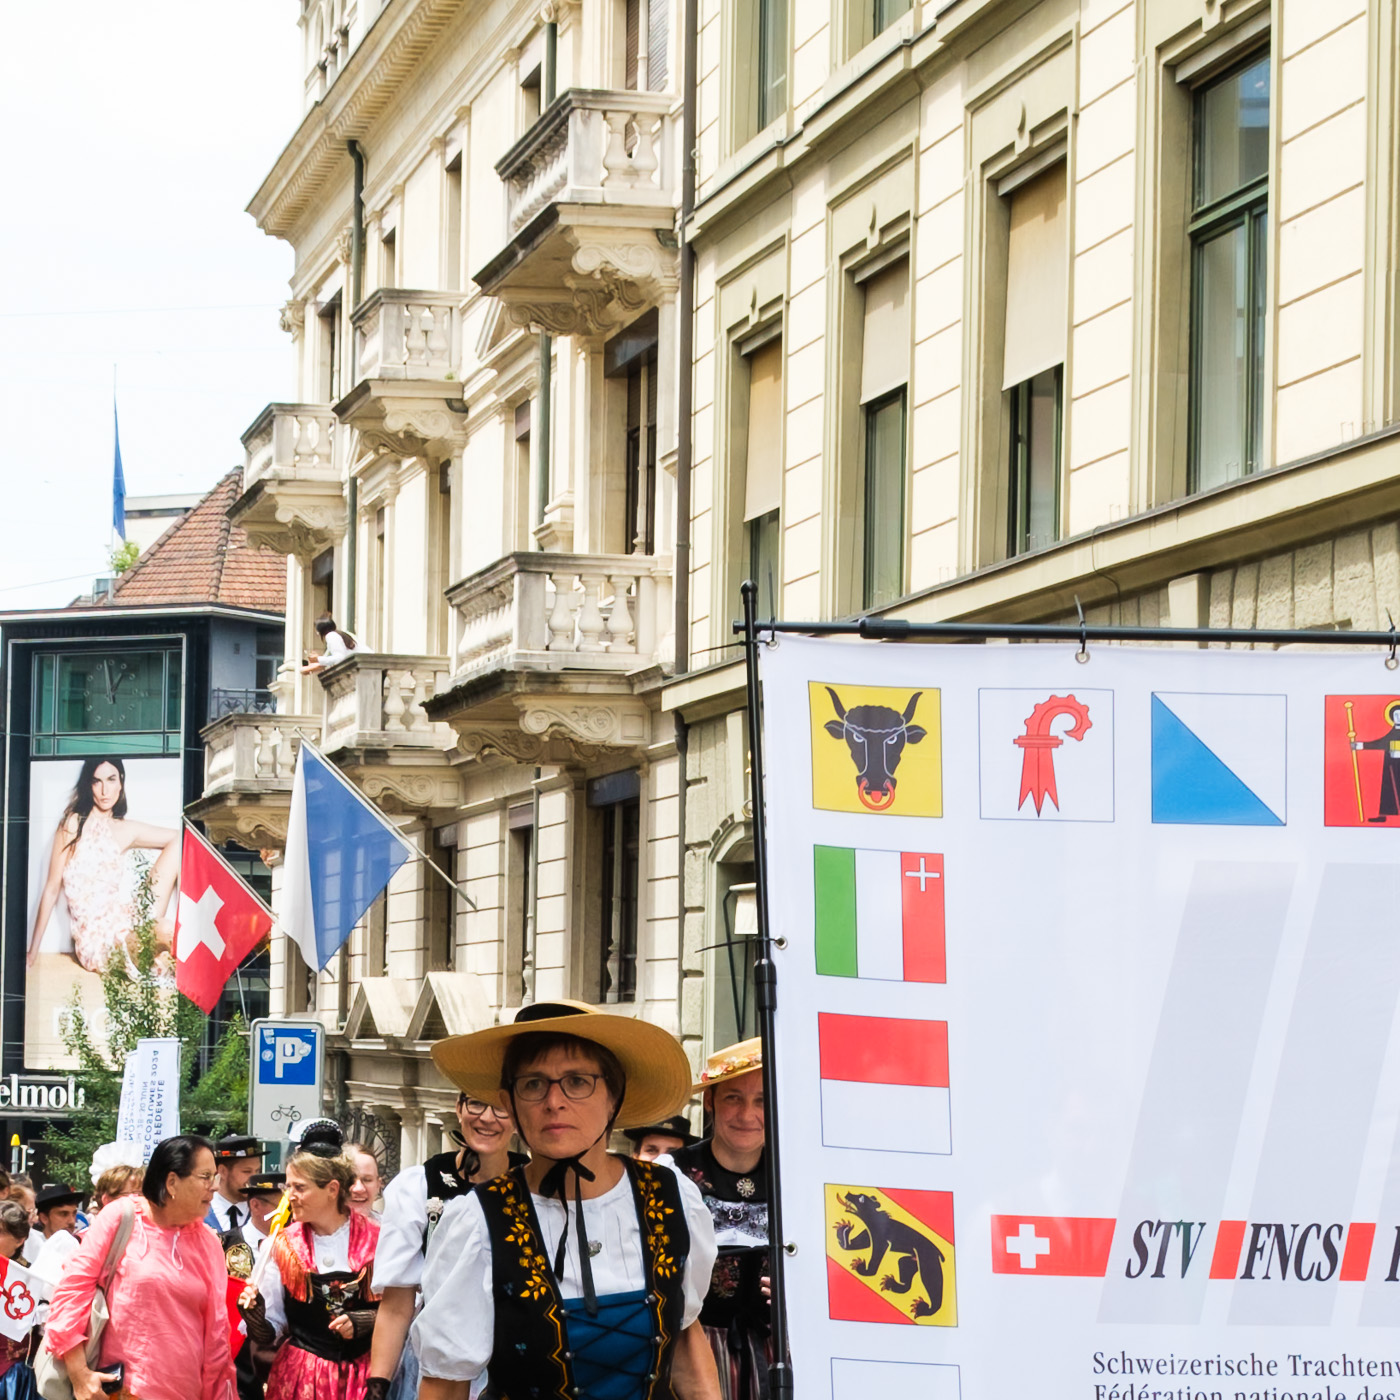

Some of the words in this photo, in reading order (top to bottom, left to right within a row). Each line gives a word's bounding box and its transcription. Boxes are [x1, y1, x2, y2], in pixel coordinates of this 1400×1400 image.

[1125, 1219, 1206, 1279] STV
[1240, 1222, 1344, 1282] FNCS
[1092, 1351, 1279, 1377] Schweizerische
